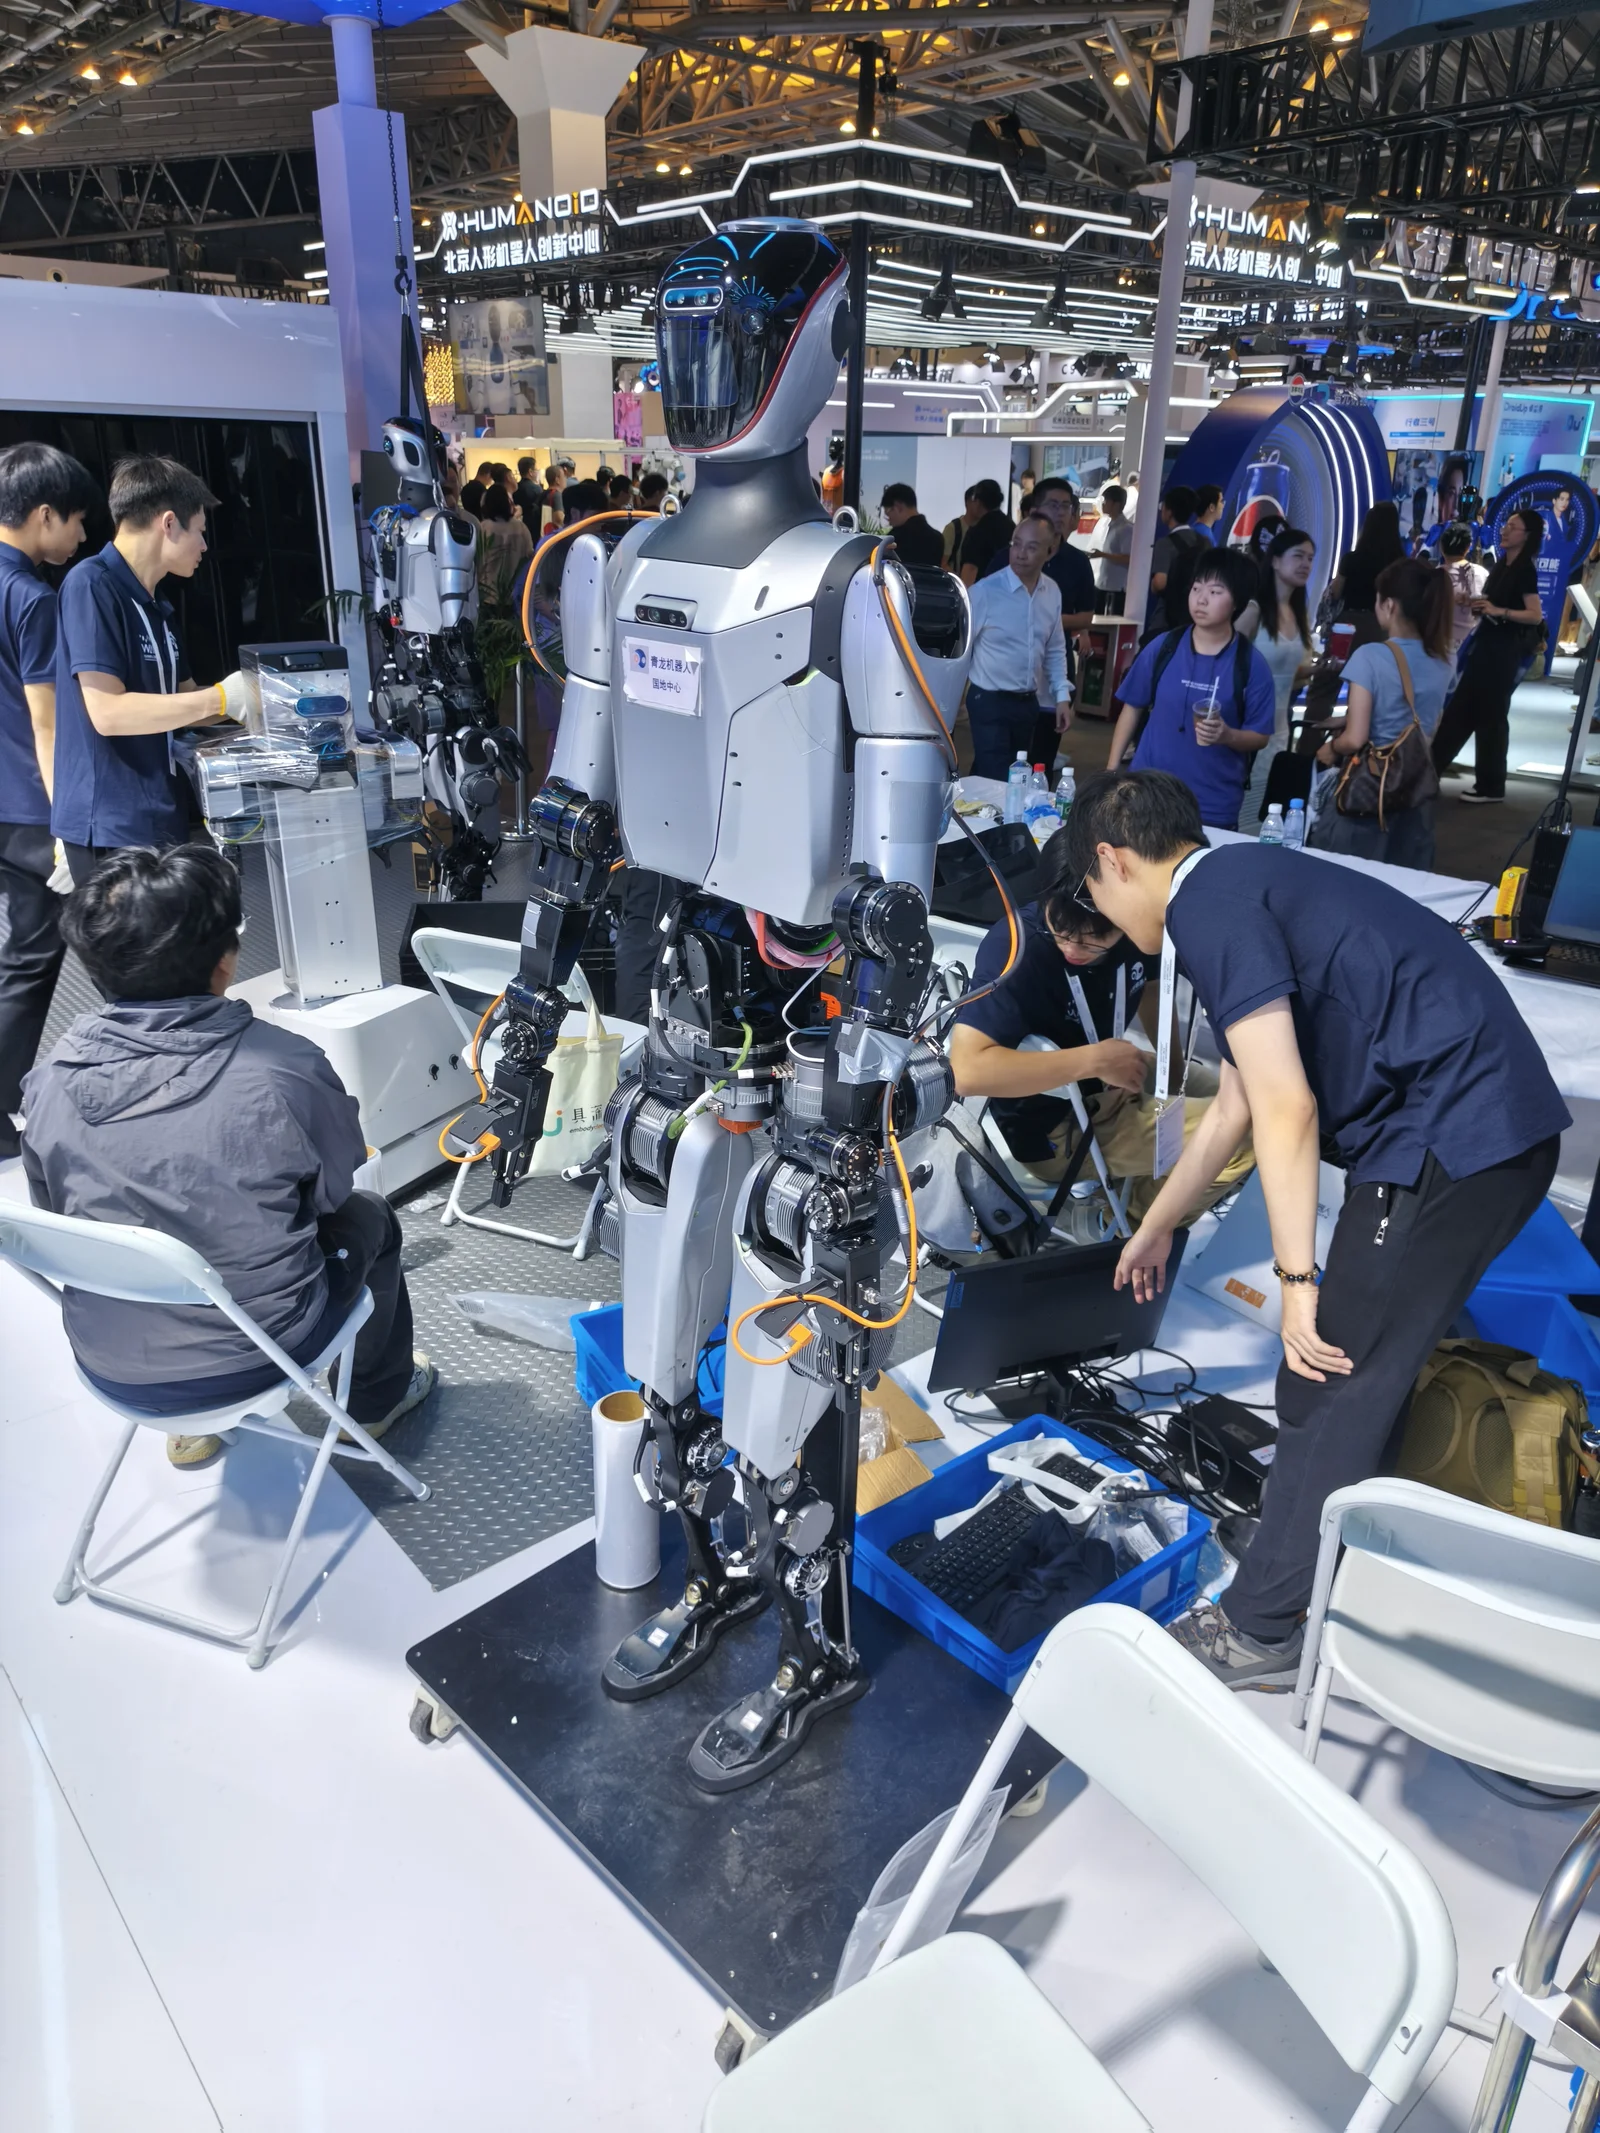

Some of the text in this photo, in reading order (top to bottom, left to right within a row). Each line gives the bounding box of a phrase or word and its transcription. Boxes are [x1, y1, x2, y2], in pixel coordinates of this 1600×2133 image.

[443, 227, 601, 274] 北京人形机器人创新中心
[1184, 240, 1344, 289] 京人形机器人创中心
[650, 655, 692, 675] 青龙机器人
[652, 677, 682, 694] 国地中心
